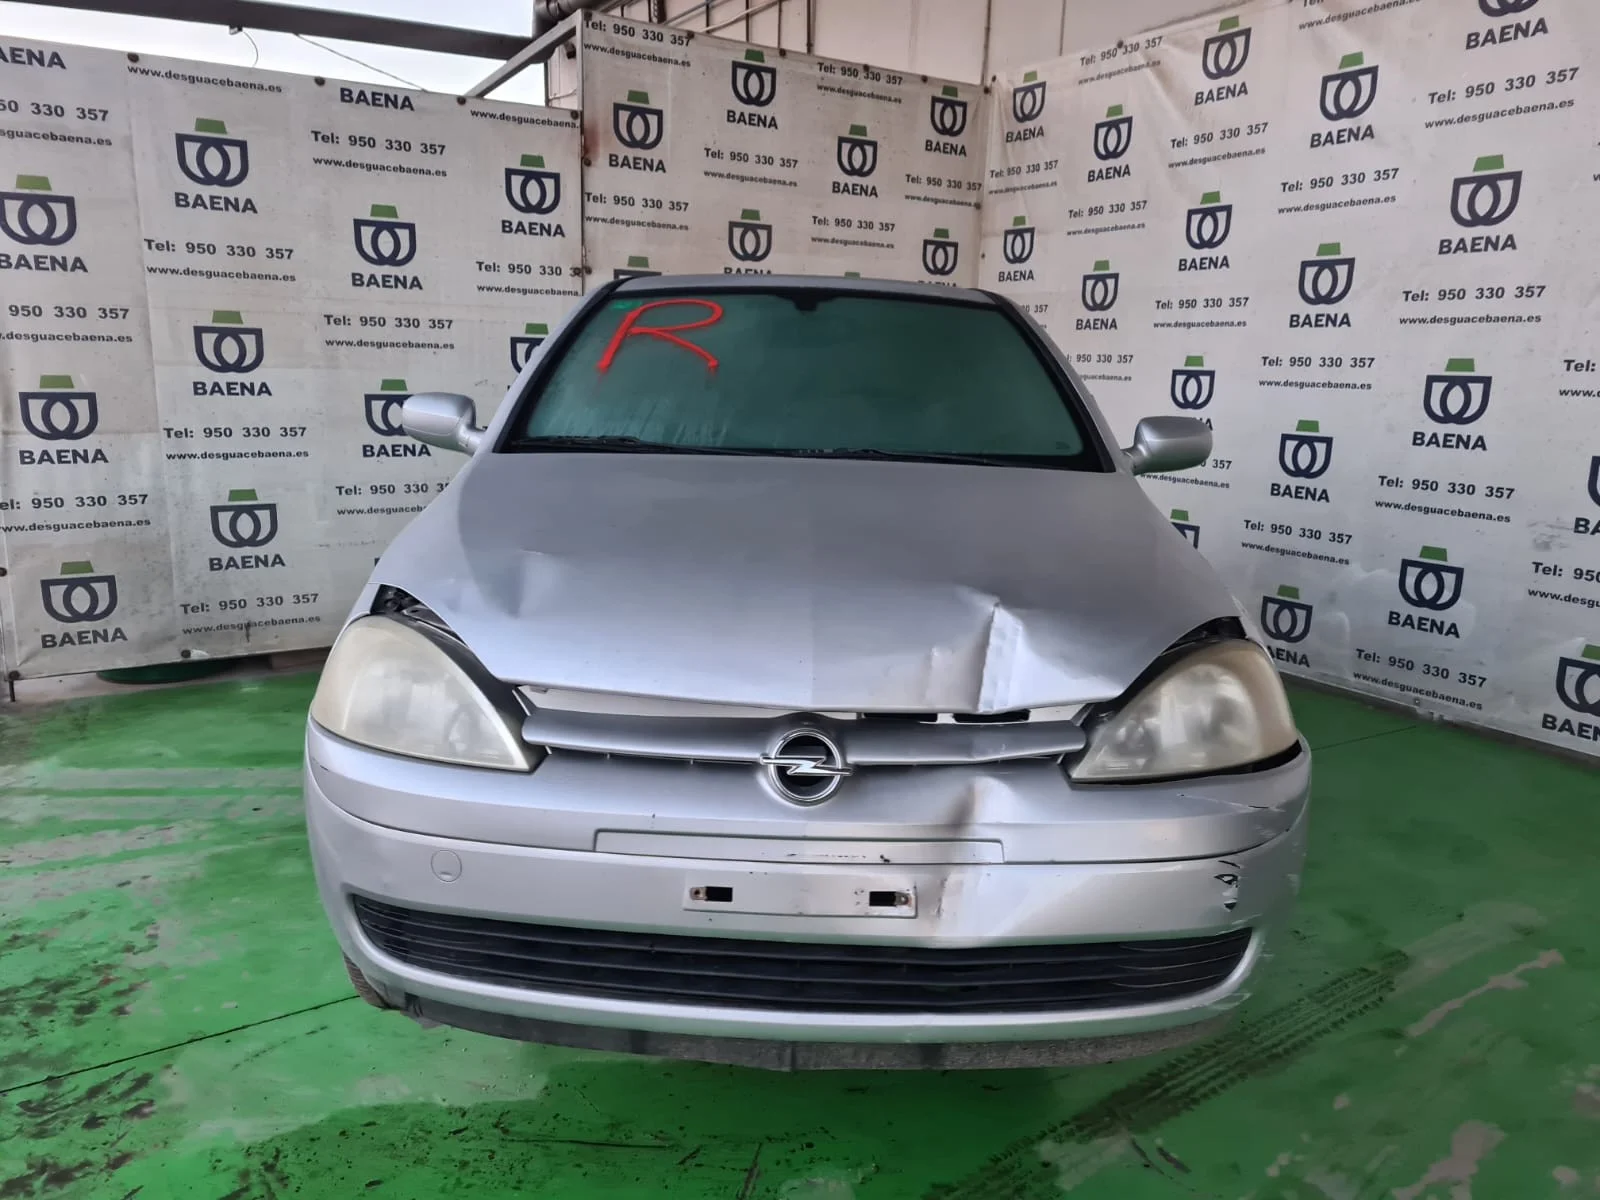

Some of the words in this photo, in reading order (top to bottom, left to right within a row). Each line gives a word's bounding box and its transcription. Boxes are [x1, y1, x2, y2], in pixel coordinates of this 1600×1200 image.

[584, 20, 606, 32] Tel:
[613, 23, 636, 37] 950
[642, 29, 664, 42] 330
[670, 34, 692, 47] 357
[1144, 35, 1163, 50] 357
[1465, 17, 1549, 50] BAENA
[583, 43, 691, 67] www.desguacebaena.es
[127, 66, 282, 93] www.desguacebaena.es
[818, 63, 836, 74] Tel:
[841, 66, 859, 78] 950
[886, 73, 903, 85] 357
[1194, 81, 1248, 106] BAENA
[1428, 89, 1456, 104] Tel:
[1465, 81, 1495, 98] 950
[1504, 74, 1536, 92] 330
[1545, 66, 1579, 85] 357
[340, 87, 415, 112] BAENA
[30, 102, 65, 118] 330
[76, 107, 109, 122] 357
[726, 109, 778, 130] BAENA
[1425, 99, 1574, 128] www.desguacebaena.es
[310, 130, 340, 144] Tel:
[348, 135, 376, 149] 950
[385, 139, 412, 152] 330
[420, 142, 446, 156] 357
[1005, 125, 1044, 143] BAENA
[1170, 137, 1188, 149] Tel:
[1193, 132, 1214, 145] 950
[1219, 127, 1240, 140] 330
[1246, 122, 1269, 136] 357
[1310, 124, 1375, 149] BAENA
[704, 147, 724, 160] Tel:
[729, 151, 749, 163] 950
[755, 154, 774, 166] 330
[779, 157, 798, 168] 357
[925, 139, 967, 157] BAENA
[313, 157, 447, 177] www.desguacebaena.es
[609, 153, 667, 174] BAENA
[1168, 148, 1266, 168] www.desguacebaena.es
[905, 174, 922, 184] Tel:
[926, 176, 942, 187] 950
[947, 179, 962, 189] 330
[966, 181, 982, 191] 357
[1087, 164, 1131, 183] BAENA
[1280, 180, 1303, 193] Tel:
[1310, 176, 1334, 190] 950
[1341, 172, 1366, 186] 330
[1373, 167, 1399, 182] 357
[832, 181, 878, 198] BAENA
[174, 192, 258, 214] BAENA
[584, 192, 607, 204] Tel:
[613, 195, 635, 207] 950
[642, 198, 663, 210] 330
[668, 201, 689, 212] 357
[1068, 208, 1084, 219] Tel:
[1088, 205, 1104, 217] 950
[1108, 203, 1125, 214] 330
[1130, 200, 1148, 211] 357
[1278, 195, 1396, 214] www.desguacebaena.es
[501, 219, 566, 238] BAENA
[585, 215, 689, 231] www.desguacebaena.es
[812, 215, 829, 226] Tel:
[834, 218, 852, 228] 950
[857, 220, 874, 230] 330
[879, 222, 895, 232] 357
[143, 238, 176, 252] Tel:
[185, 242, 216, 255] 950
[226, 245, 256, 258] 330
[265, 247, 294, 260] 357
[1438, 234, 1517, 255] BAENA
[0, 253, 88, 273] BAENA
[475, 261, 500, 273] Tel:
[508, 263, 532, 275] 950
[539, 265, 562, 276] 330
[1178, 255, 1230, 272] BAENA
[146, 266, 296, 282] www.desguacebaena.es
[351, 272, 423, 291] BAENA
[998, 269, 1034, 282] BAENA
[1402, 290, 1429, 302] Tel:
[1437, 288, 1466, 301] 950
[1475, 286, 1505, 300] 330
[1514, 285, 1546, 299] 357
[8, 304, 43, 317] 950
[53, 306, 87, 319] 330
[98, 307, 129, 320] 357
[1155, 300, 1173, 310] Tel:
[1178, 298, 1197, 309] 950
[1203, 297, 1223, 308] 330
[1228, 297, 1250, 308] 357
[323, 314, 351, 326] Tel:
[359, 316, 386, 327] 950
[394, 317, 420, 329] 330
[428, 318, 453, 330] 357
[1075, 318, 1118, 331] BAENA
[1153, 320, 1247, 330] www.desguacebaena.es
[1289, 312, 1351, 328] BAENA
[1399, 314, 1542, 326] www.desguacebaena.es
[325, 339, 455, 350] www.desguacebaena.es
[595, 298, 724, 373] R
[1076, 354, 1092, 364] 950
[1096, 354, 1113, 364] 330
[1117, 354, 1134, 364] 357
[1261, 356, 1283, 367] Tel:
[1289, 356, 1312, 367] 950
[1318, 356, 1343, 368] 330
[1349, 357, 1376, 368] 357
[1563, 359, 1596, 372] Tel:
[192, 381, 273, 397] BAENA
[1259, 379, 1372, 390] www.desguacebaena.es
[163, 427, 194, 439] Tel:
[203, 427, 233, 438] 950
[242, 426, 271, 438] 330
[280, 426, 307, 437] 357
[1412, 431, 1488, 451] BAENA
[19, 448, 109, 465] BAENA
[166, 450, 309, 461] www.desguacebaena.es
[361, 443, 431, 458] BAENA
[1212, 459, 1232, 470] 357
[335, 485, 362, 496] Tel:
[370, 484, 396, 495] 950
[404, 483, 429, 494] 330
[1270, 483, 1330, 503] BAENA
[1378, 475, 1404, 488] Tel:
[1412, 478, 1439, 492] 950
[1447, 482, 1476, 496] 330
[1485, 485, 1515, 500] 357
[31, 497, 64, 509] 950
[75, 495, 107, 508] 330
[117, 494, 148, 506] 357
[1375, 501, 1511, 523] www.desguacebaena.es
[1244, 519, 1264, 532] Tel:
[1270, 523, 1292, 536] 950
[1299, 528, 1322, 540] 330
[1328, 532, 1352, 544] 357
[208, 553, 286, 572] BAENA
[1241, 541, 1350, 565] www.desguacebaena.es
[1532, 561, 1563, 577] Tel:
[180, 602, 210, 615] Tel:
[218, 599, 247, 611] 950
[256, 596, 284, 607] 330
[293, 593, 319, 604] 357
[1388, 610, 1460, 639] BAENA
[41, 627, 128, 649] BAENA
[1355, 648, 1381, 663] Tel:
[1388, 656, 1415, 671] 950
[1422, 664, 1450, 680] 330
[1458, 672, 1487, 688] 357
[1353, 672, 1483, 711] www.desguacebaena.es
